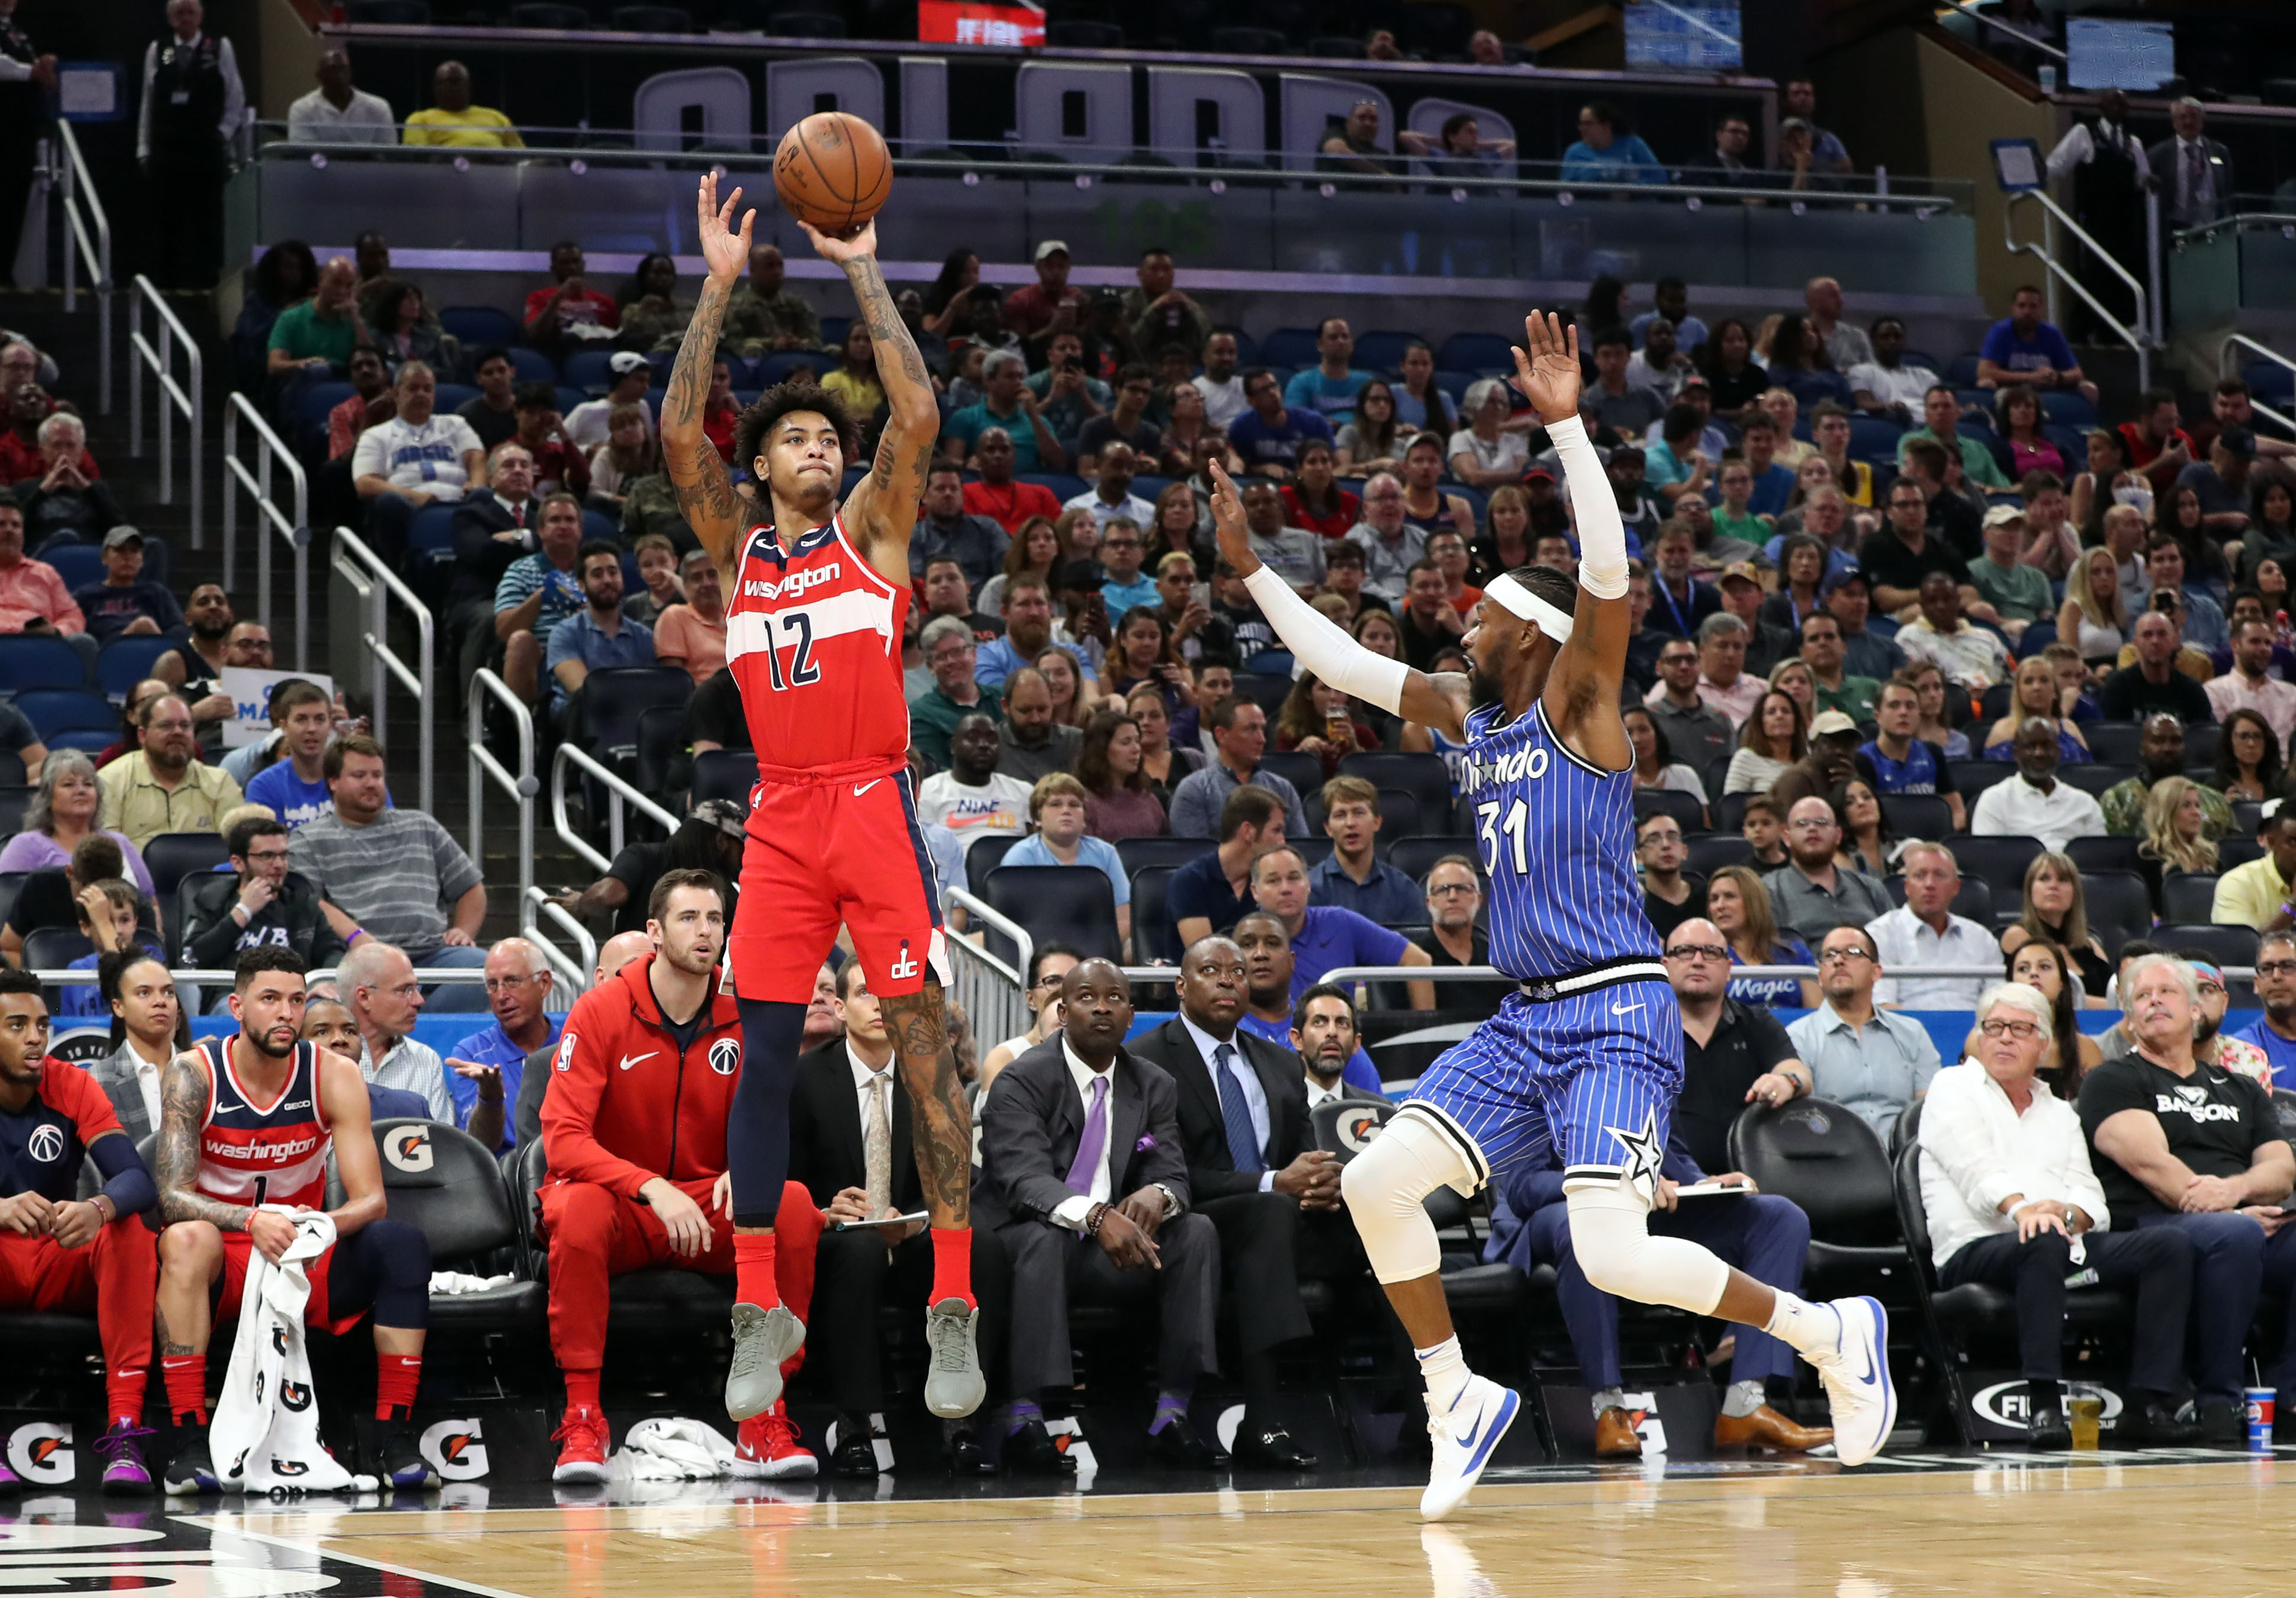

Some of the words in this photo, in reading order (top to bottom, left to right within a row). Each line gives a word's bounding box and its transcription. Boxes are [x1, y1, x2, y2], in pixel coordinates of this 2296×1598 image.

[764, 612, 821, 692] 12
[957, 799, 1000, 813] NIKE
[986, 813, 1017, 828] AIR
[1477, 798, 1528, 877] 31
[1728, 978, 1796, 1002] Magic
[284, 1099, 311, 1111] GECO
[2155, 1094, 2240, 1124] BASON
[206, 1137, 317, 1163] washington
[252, 1174, 268, 1210] 1
[7, 1422, 76, 1484] G
[419, 1418, 490, 1480] G
